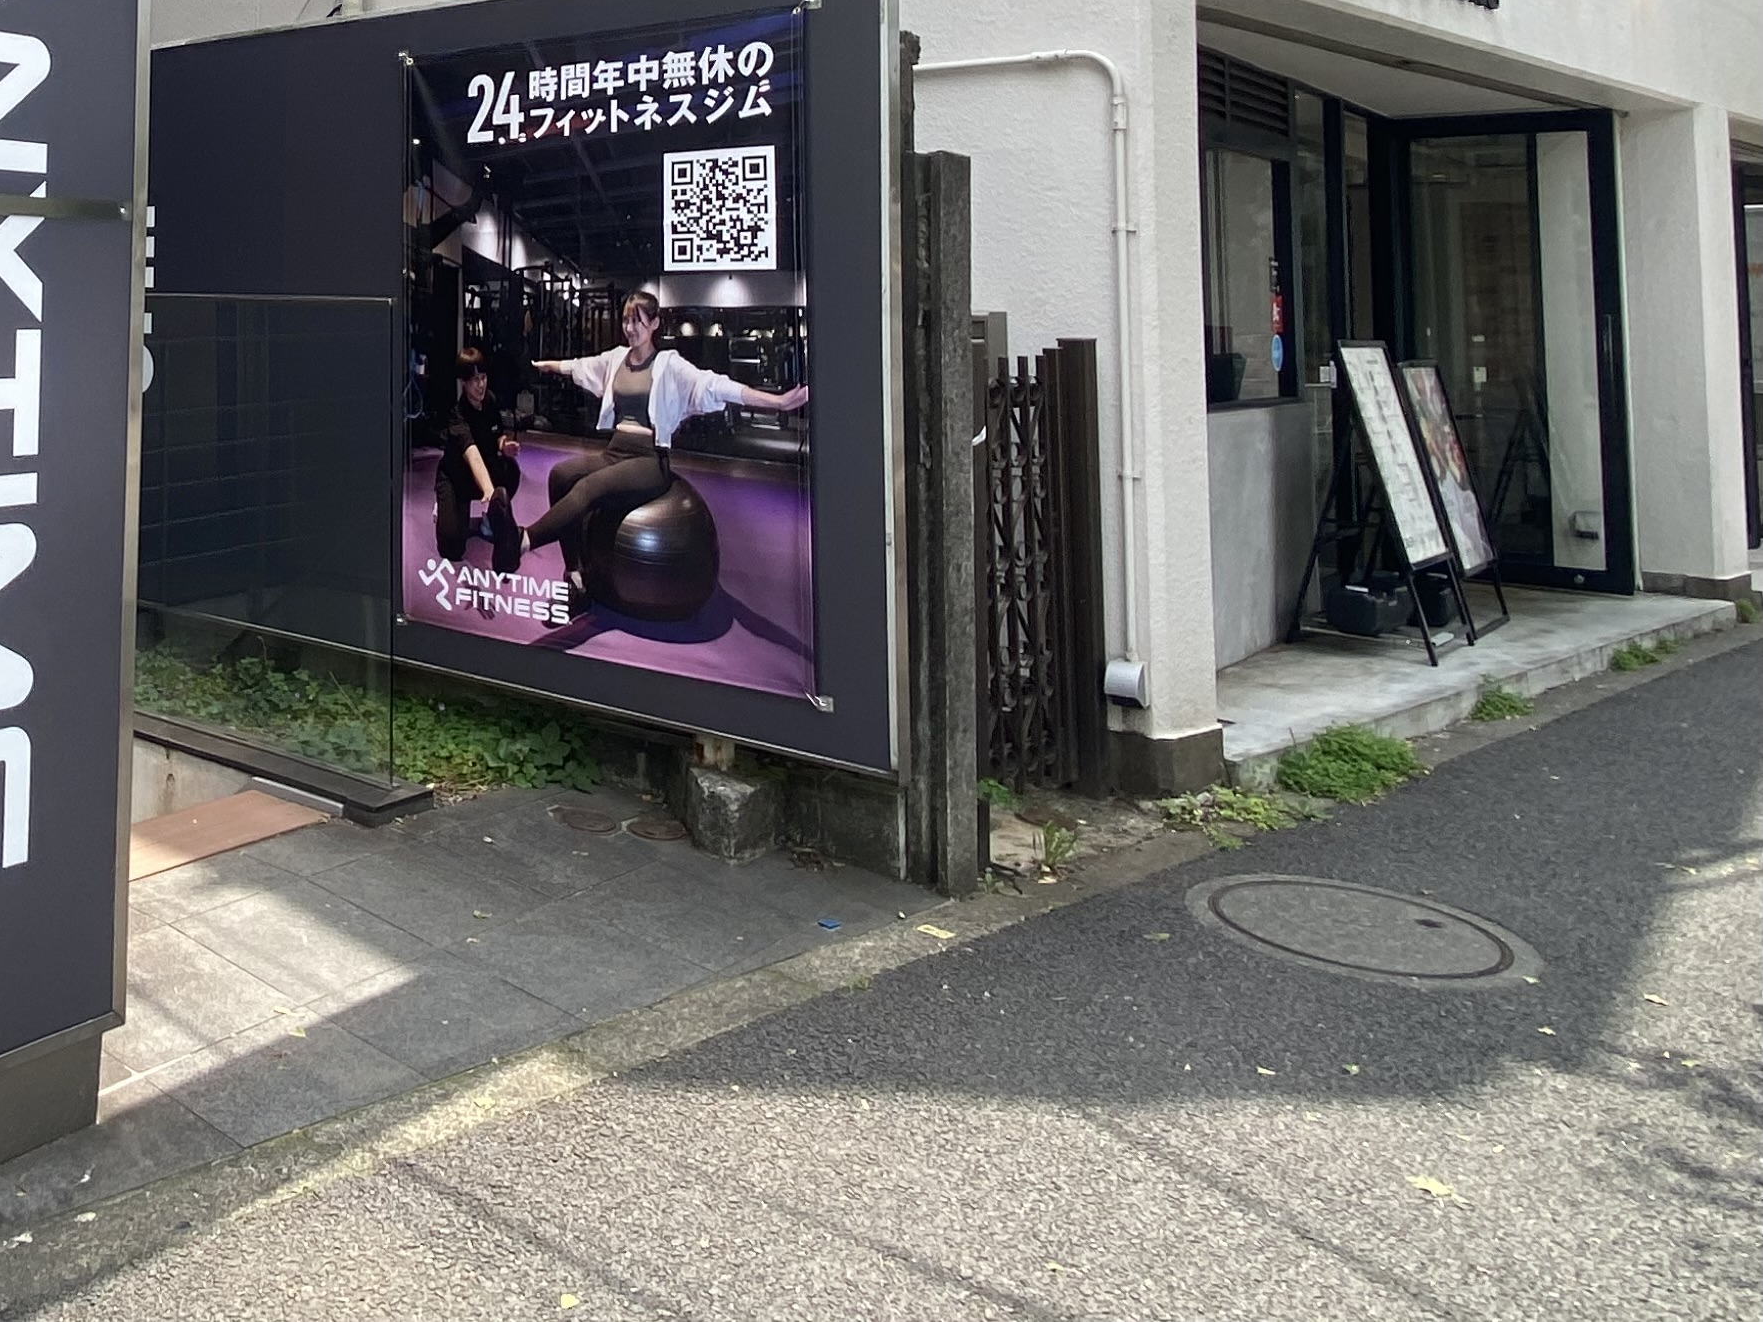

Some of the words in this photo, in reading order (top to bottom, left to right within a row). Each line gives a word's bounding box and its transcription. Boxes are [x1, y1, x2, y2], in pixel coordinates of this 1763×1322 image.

[529, 79, 774, 139] フィットネスジム
[457, 566, 570, 602] ANYTIME
[455, 588, 571, 625] FITNESS
